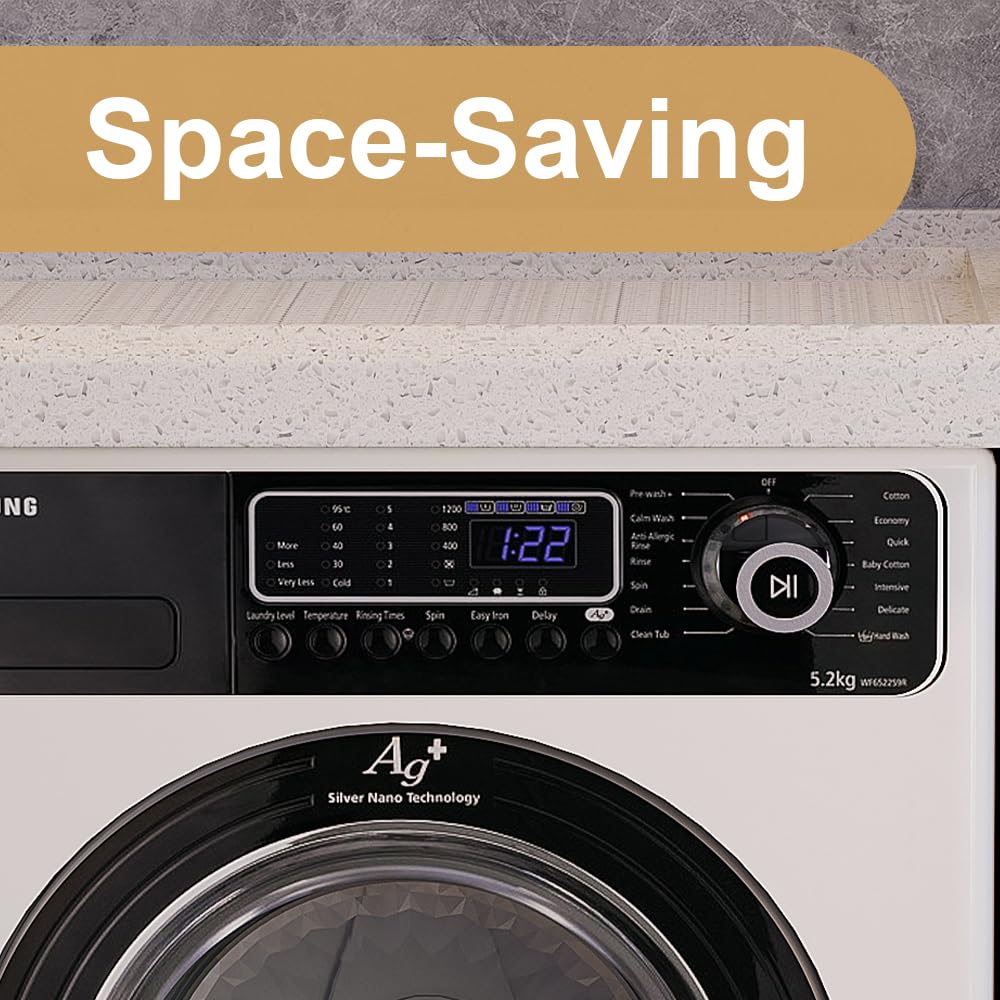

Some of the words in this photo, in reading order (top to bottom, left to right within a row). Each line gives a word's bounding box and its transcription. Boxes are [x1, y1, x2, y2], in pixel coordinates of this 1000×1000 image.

[761, 478, 776, 486] OFF
[882, 491, 910, 501] Cotton
[0, 496, 38, 517] NG
[387, 504, 393, 514] 5
[442, 504, 463, 514] 1200
[652, 513, 675, 523] Wash
[874, 516, 910, 526] Economy
[332, 522, 344, 532] 60
[387, 522, 394, 531] 4
[442, 522, 458, 532] 800
[277, 541, 299, 550] More
[332, 541, 344, 550] 40
[387, 541, 393, 550] 3
[442, 541, 458, 550] 400
[501, 525, 571, 563] 1:22
[886, 537, 910, 548] Quick
[277, 560, 295, 569] Less
[332, 559, 344, 569] 30
[387, 559, 393, 569] 2
[630, 557, 652, 566] Rinse
[862, 559, 881, 571] Baby
[882, 559, 910, 569] Cotton
[277, 577, 296, 588] Very
[297, 578, 315, 587] Less
[332, 578, 351, 588] Cold
[387, 578, 393, 587] 1
[630, 581, 648, 591] Spin
[874, 583, 910, 592] Intensive
[630, 605, 652, 614] Drain
[877, 605, 910, 614] Delicate
[246, 610, 275, 622] Laundry
[276, 610, 296, 620] Level
[303, 610, 349, 622] Temperature
[425, 610, 445, 622] Spin
[470, 610, 491, 622] Easy
[492, 610, 509, 620] Iron
[531, 610, 557, 622] Delay
[630, 630, 652, 639] Clean
[654, 629, 670, 639] Tub
[810, 670, 856, 692] 5.2kg
[327, 791, 365, 804] Silver
[367, 792, 403, 804] Nano
[405, 791, 481, 807] Technology
